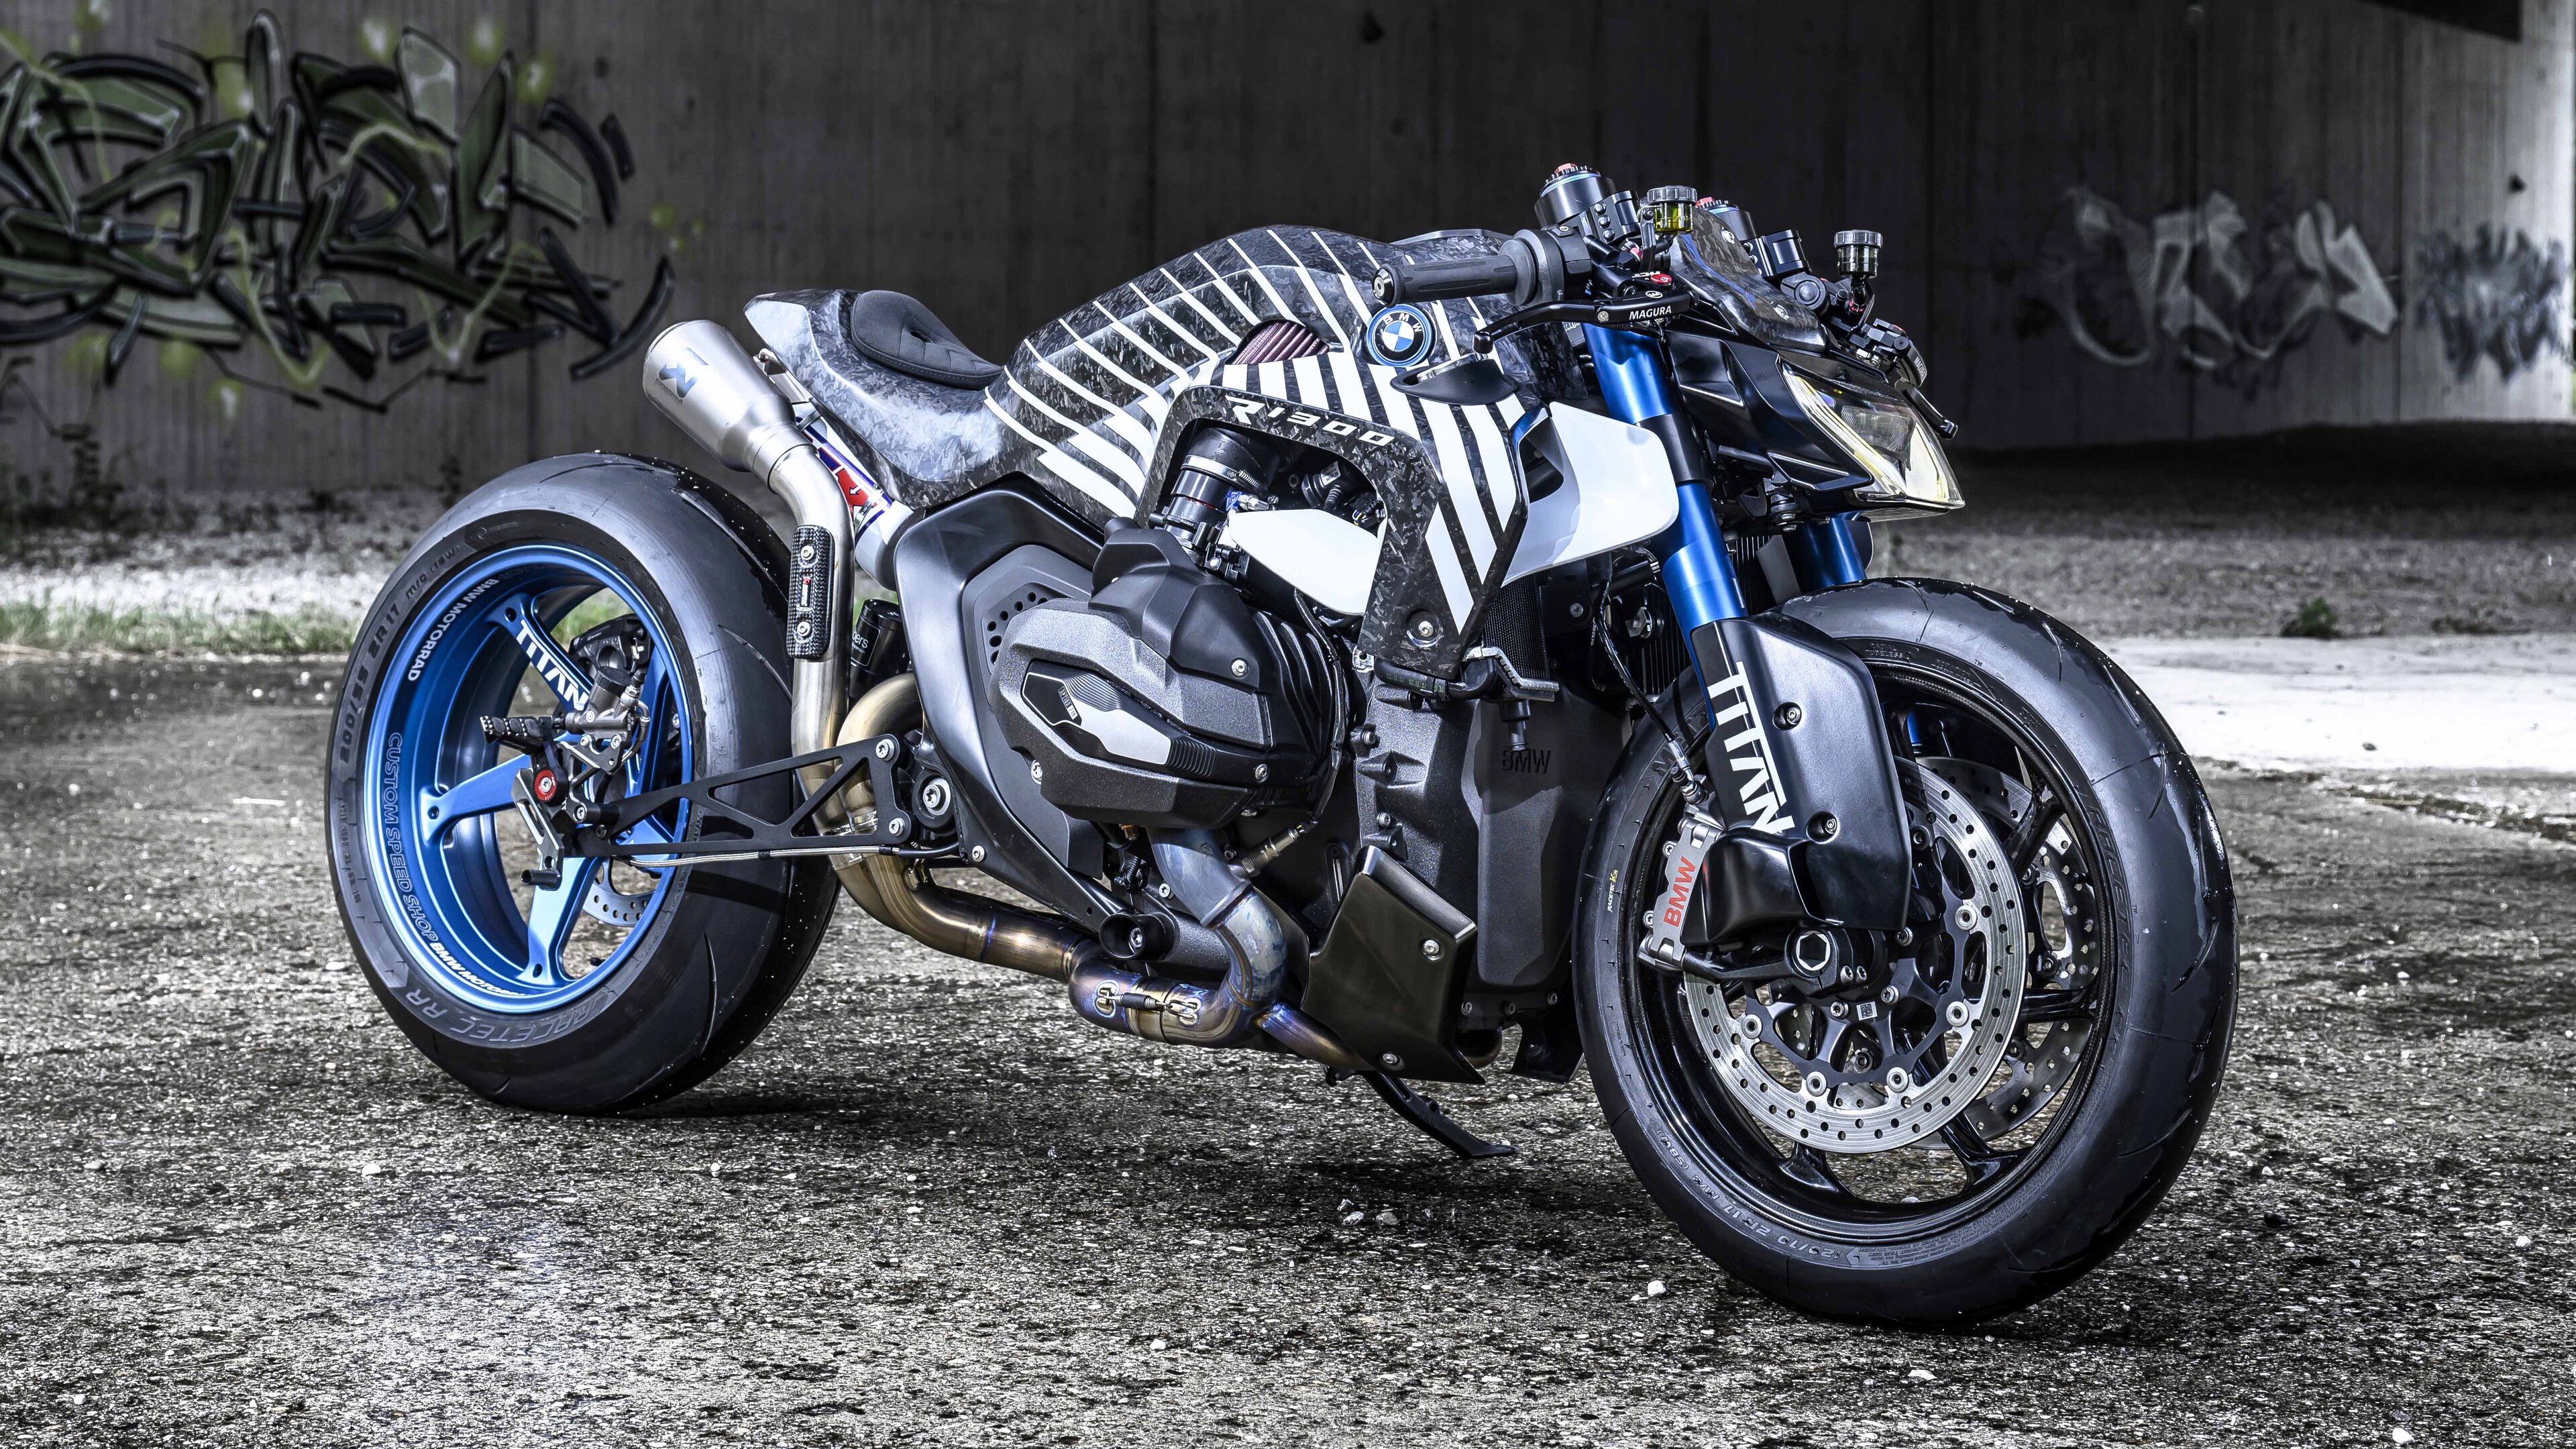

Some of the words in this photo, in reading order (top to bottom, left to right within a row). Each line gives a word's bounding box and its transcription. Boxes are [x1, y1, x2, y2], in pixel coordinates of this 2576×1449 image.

[1383, 312, 1423, 333] BMW
[1629, 305, 1672, 321] MAGURA
[1225, 395, 1395, 447] R1300
[464, 578, 500, 603] BMW
[408, 602, 468, 681] MOTORRAD
[517, 619, 589, 711] TITAN
[339, 665, 368, 763] 200/55
[1501, 746, 1551, 774] BMW
[1707, 661, 1796, 835] TITAN
[382, 732, 402, 824] CUSTOM
[386, 827, 412, 893] SPEED
[1664, 856, 1696, 928] BMW
[403, 895, 439, 942] SHOP
[429, 943, 466, 971] BMW
[450, 1004, 590, 1042] RACETEC
[1778, 1234, 1843, 1260] 120/70
